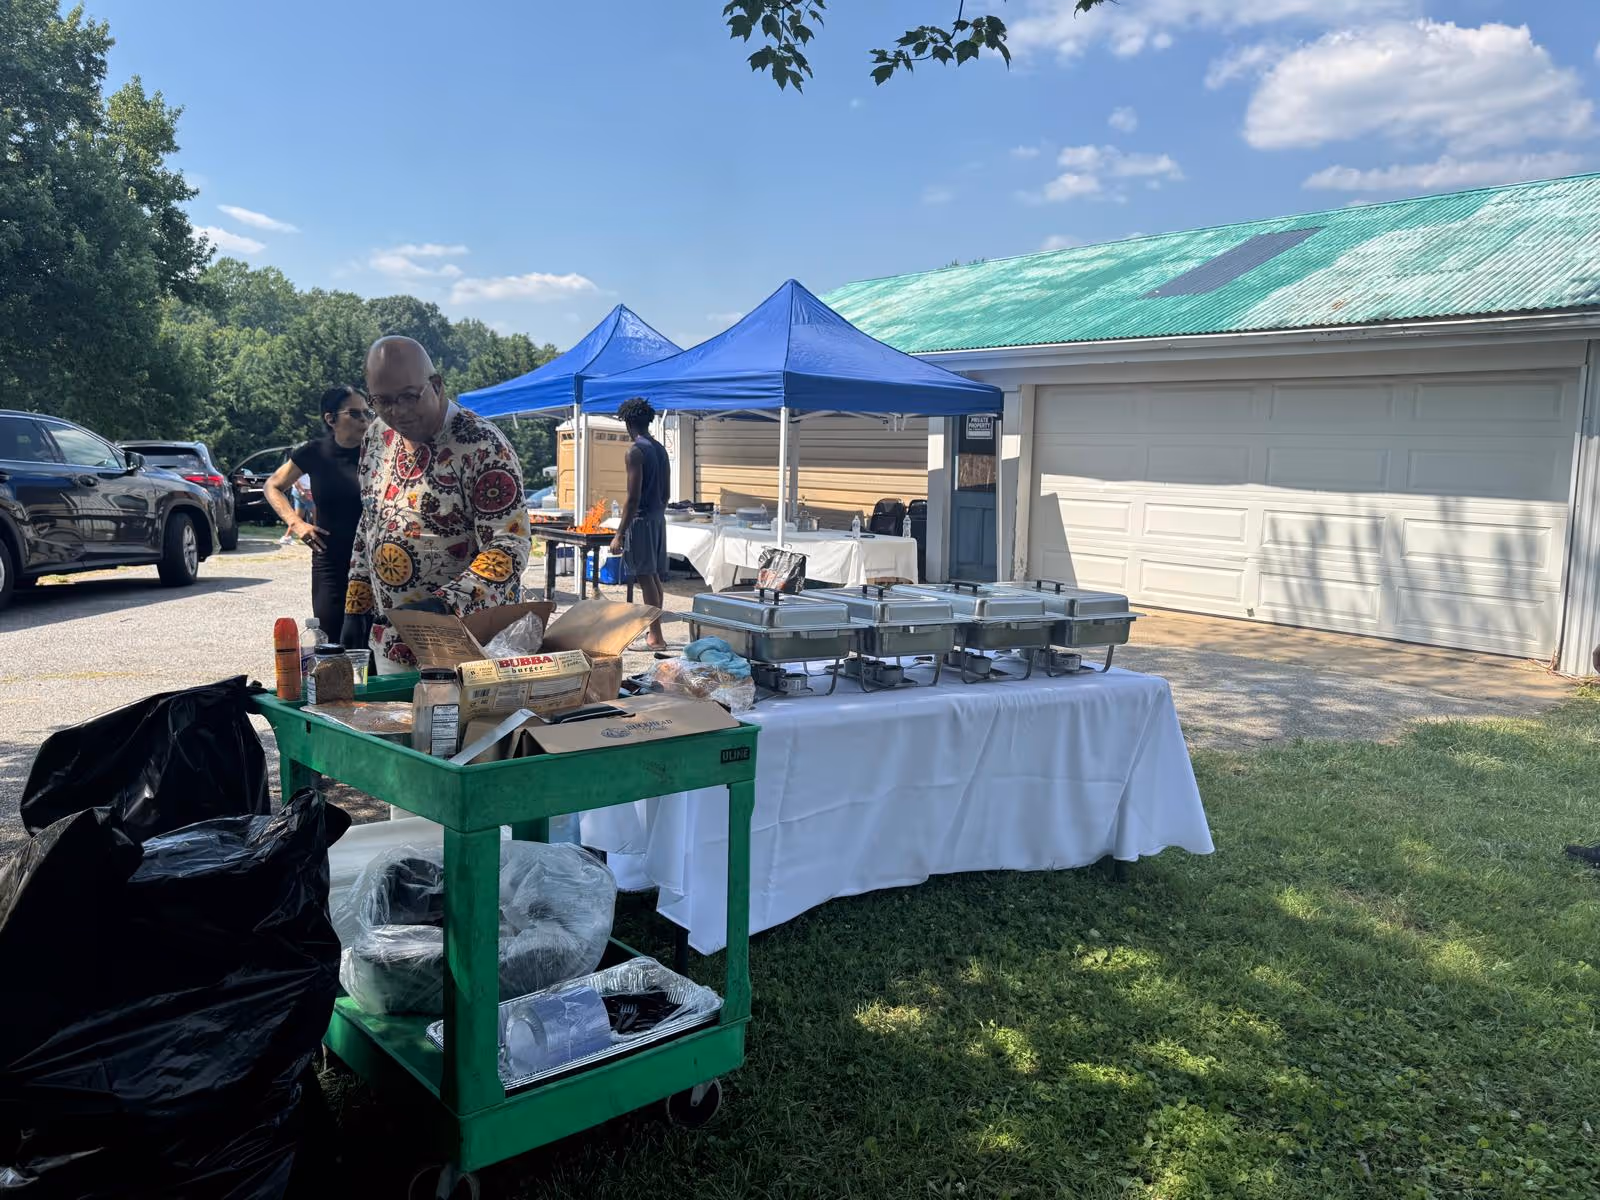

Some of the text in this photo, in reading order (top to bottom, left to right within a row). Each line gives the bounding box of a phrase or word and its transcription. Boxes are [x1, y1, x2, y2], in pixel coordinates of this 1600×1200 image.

[497, 655, 553, 668] BUBBA
[511, 665, 544, 674] burger
[722, 748, 748, 761] ULINE
